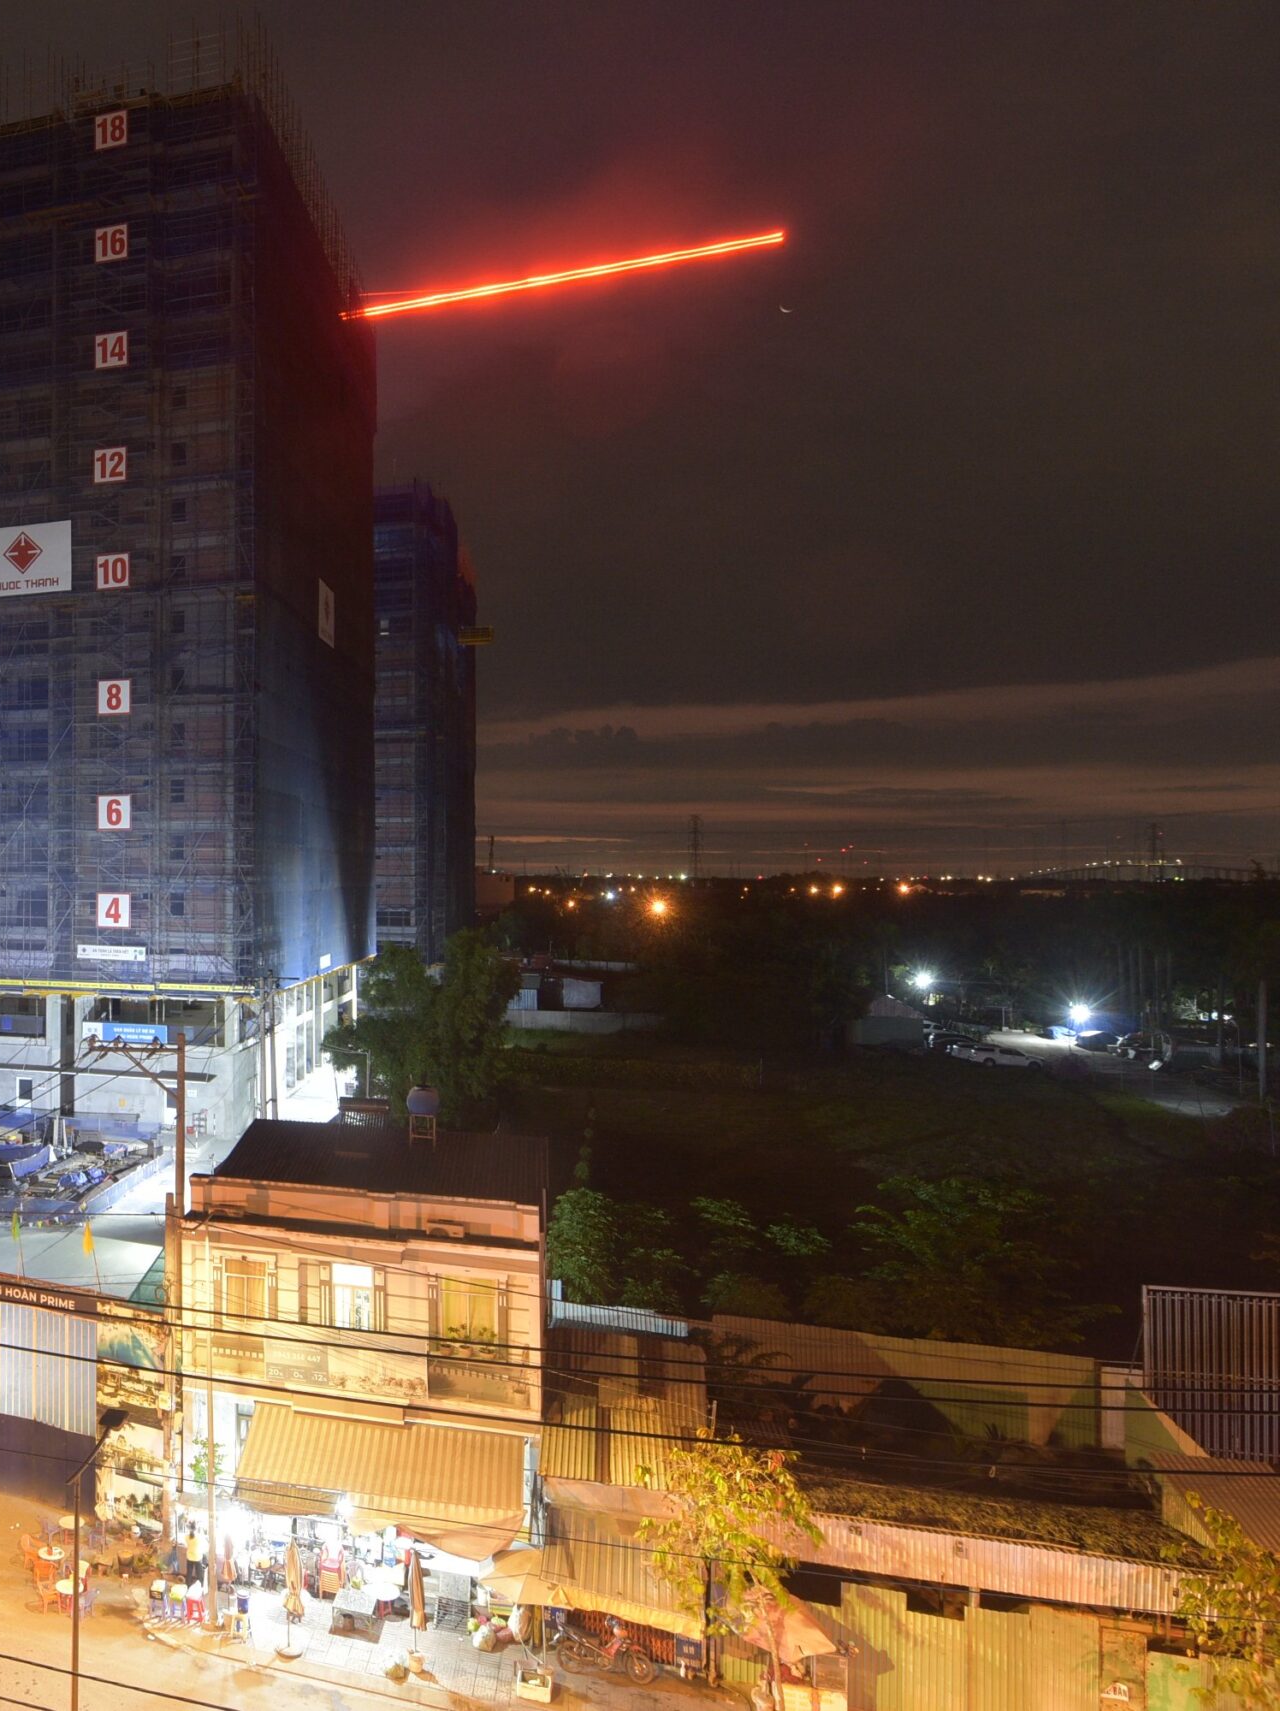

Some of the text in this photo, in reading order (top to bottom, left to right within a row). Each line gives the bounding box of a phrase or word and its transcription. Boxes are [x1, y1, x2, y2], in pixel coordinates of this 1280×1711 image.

[97, 115, 125, 144] 18
[97, 229, 125, 257] 16
[97, 336, 125, 363] 14
[96, 451, 124, 479] 12
[24, 577, 59, 589] THANH
[98, 557, 126, 584] 10
[106, 684, 122, 710] 8
[106, 799, 122, 826] 6
[105, 897, 121, 924] 4
[40, 1294, 76, 1310] PRIME
